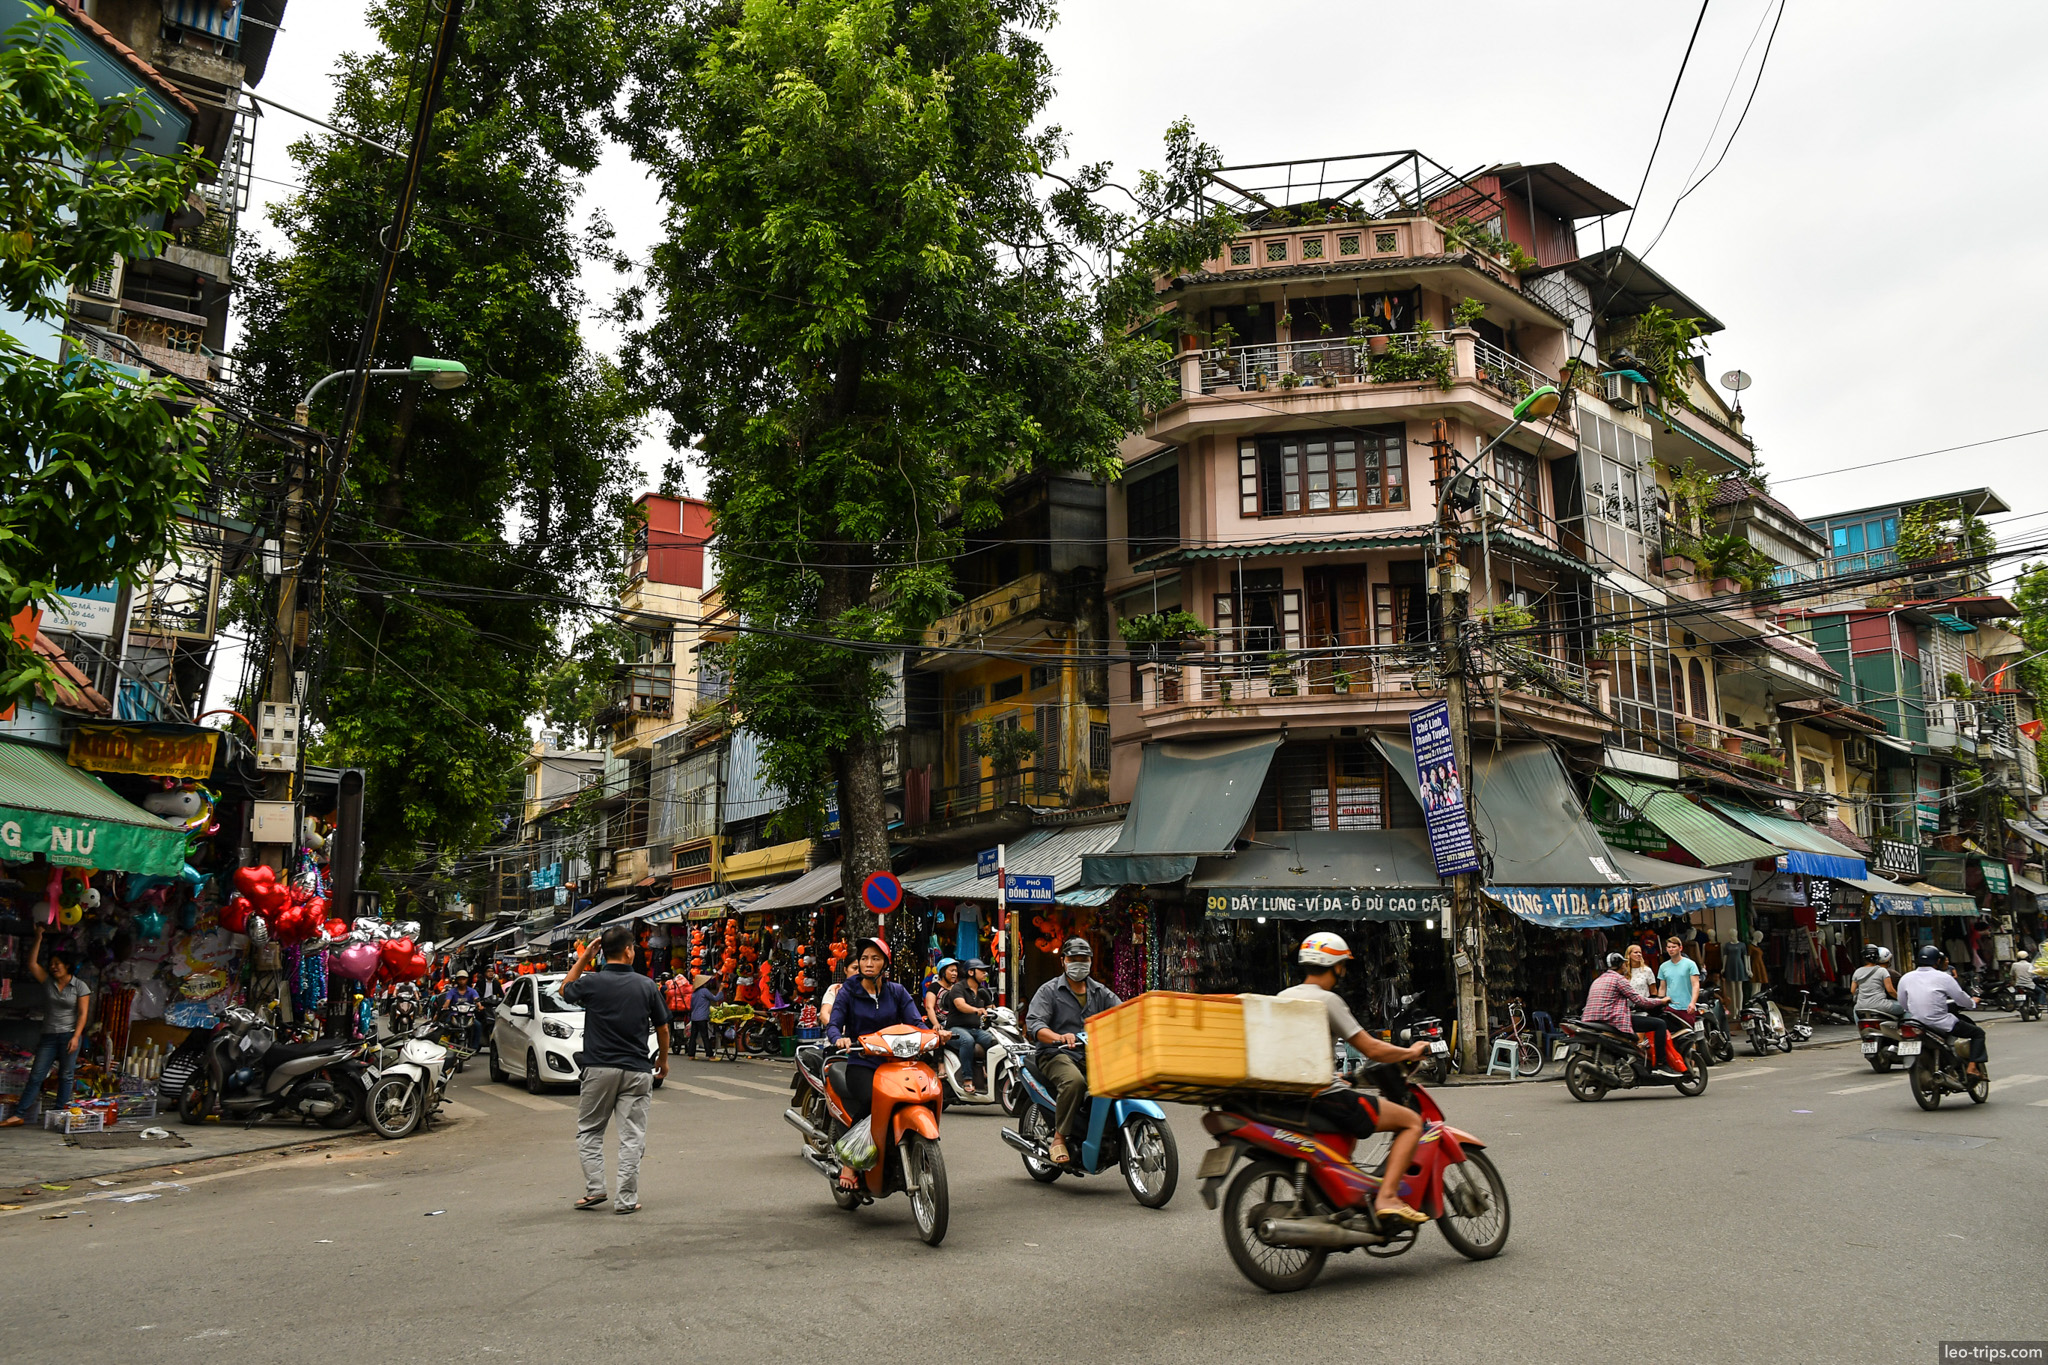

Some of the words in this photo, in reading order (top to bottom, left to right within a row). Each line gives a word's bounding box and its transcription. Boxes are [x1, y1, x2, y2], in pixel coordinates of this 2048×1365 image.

[50, 822, 96, 855] NỮ
[1008, 886, 1029, 898] ĐỒNG
[1031, 888, 1051, 899] XUÂN
[1693, 887, 1706, 902] DA
[1208, 896, 1227, 910] 90
[1232, 894, 1258, 910] DÂY
[1366, 894, 1383, 910] DÙ
[1389, 898, 1416, 911] CAO
[1551, 888, 1569, 915] VÍ
[1570, 893, 1590, 915] DA
